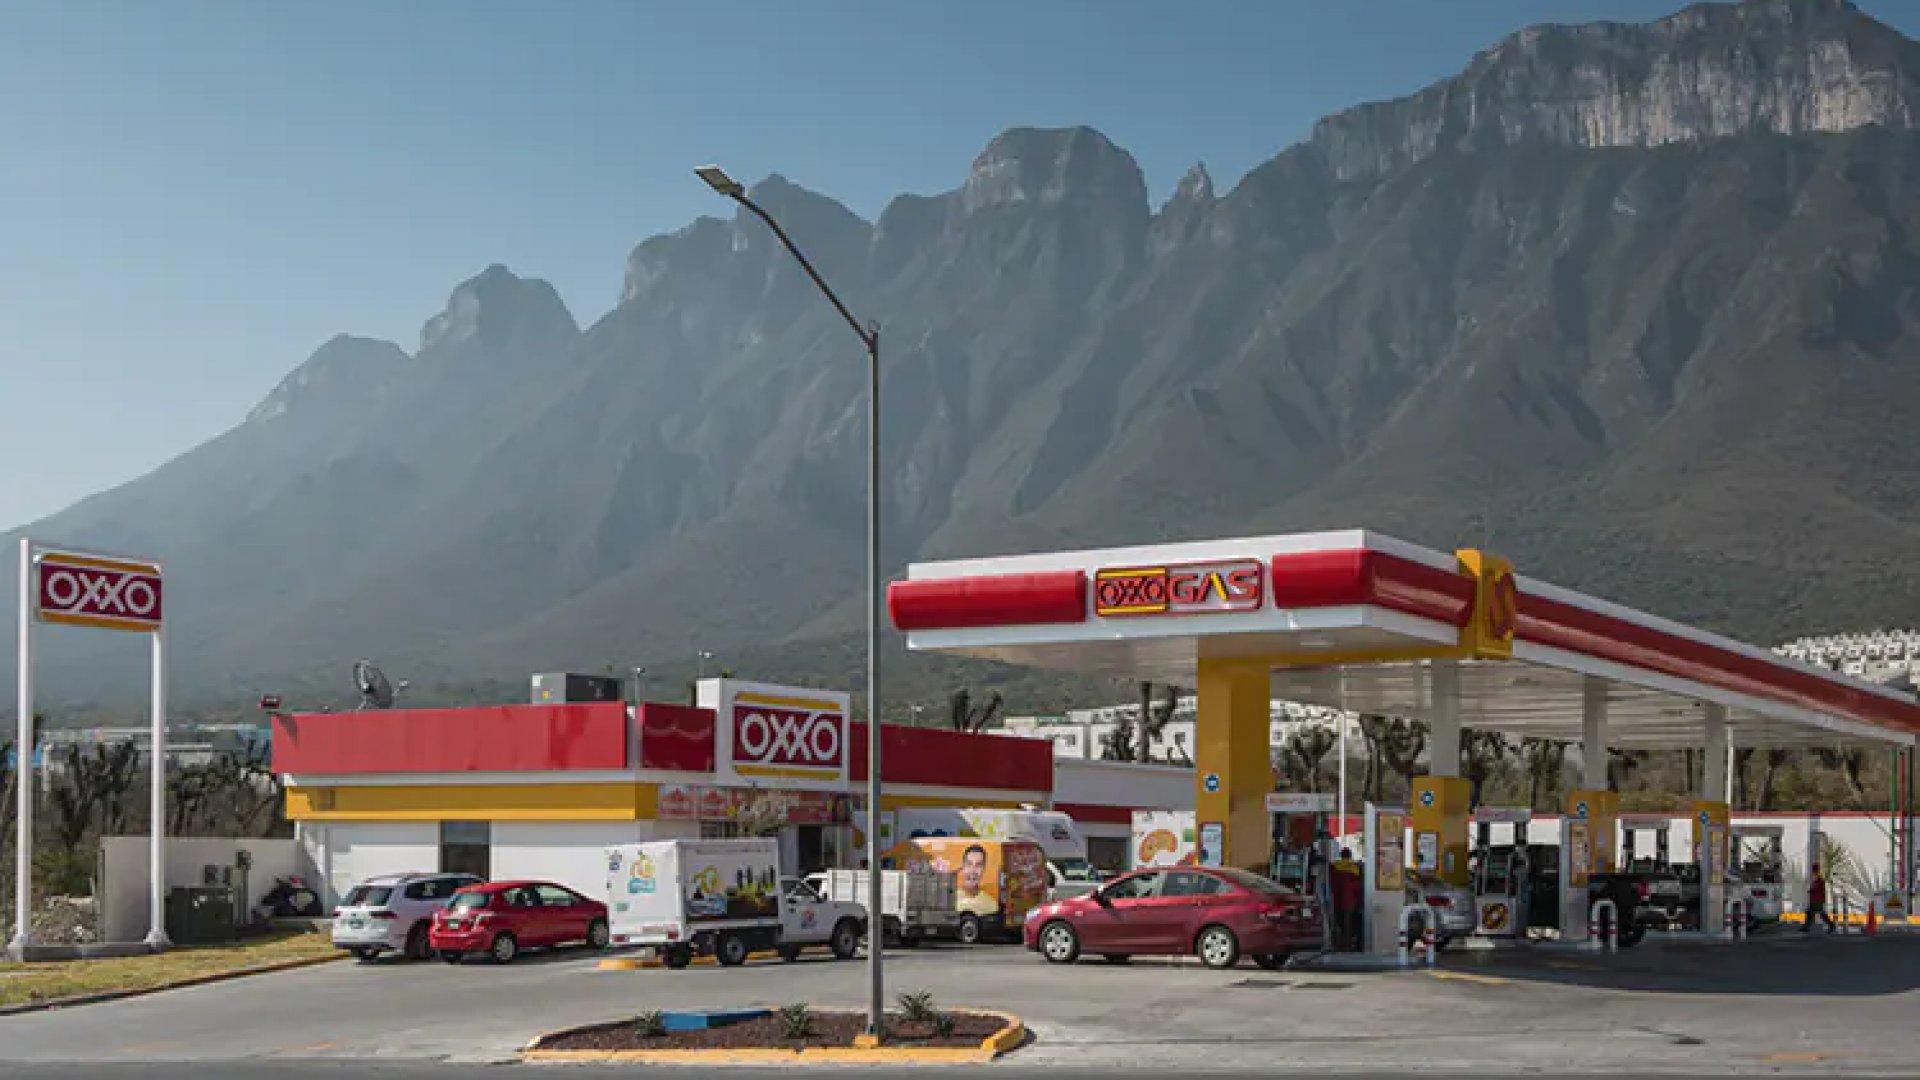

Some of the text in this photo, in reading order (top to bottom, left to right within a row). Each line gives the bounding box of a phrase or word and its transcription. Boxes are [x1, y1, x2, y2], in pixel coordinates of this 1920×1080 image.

[47, 571, 155, 614] OXXO
[1099, 570, 1258, 606] OXXO GAS
[742, 712, 838, 762] OXXO
